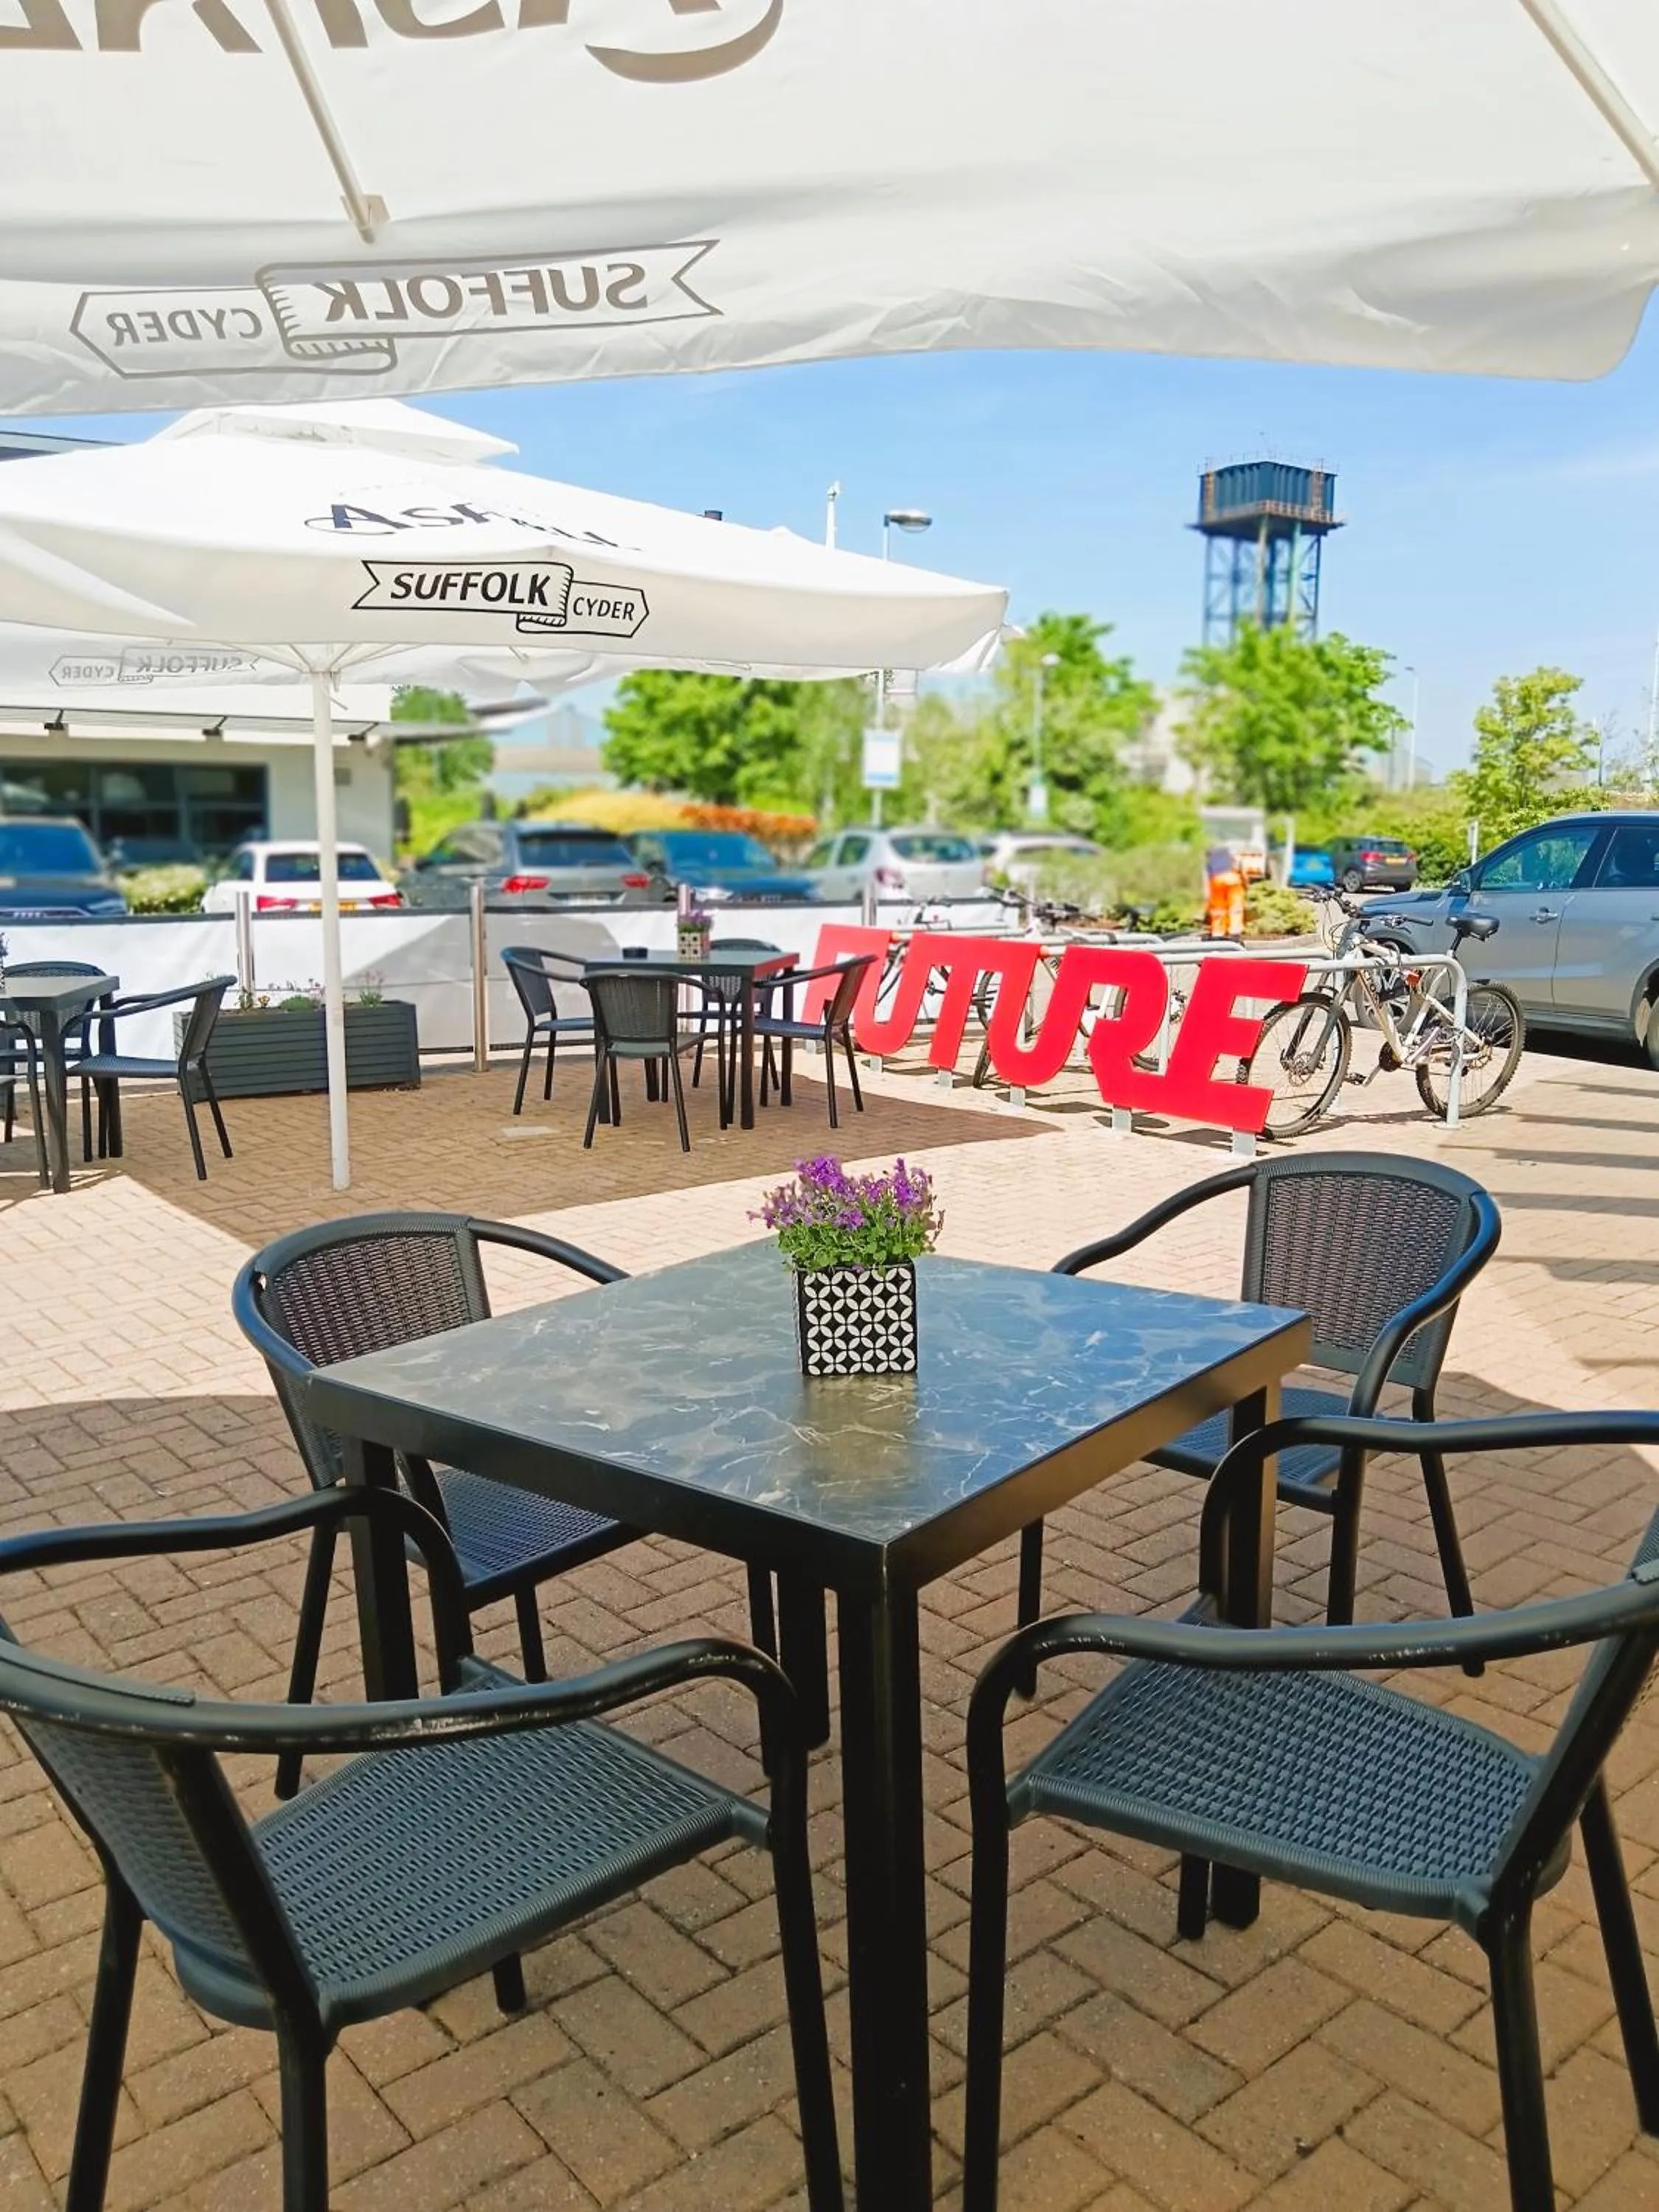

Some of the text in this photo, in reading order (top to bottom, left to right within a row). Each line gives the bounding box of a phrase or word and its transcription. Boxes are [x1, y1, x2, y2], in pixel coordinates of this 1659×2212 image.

[390, 571, 636, 622] SUFFOLK CYDER
[801, 924, 1308, 1134] FUTURE
